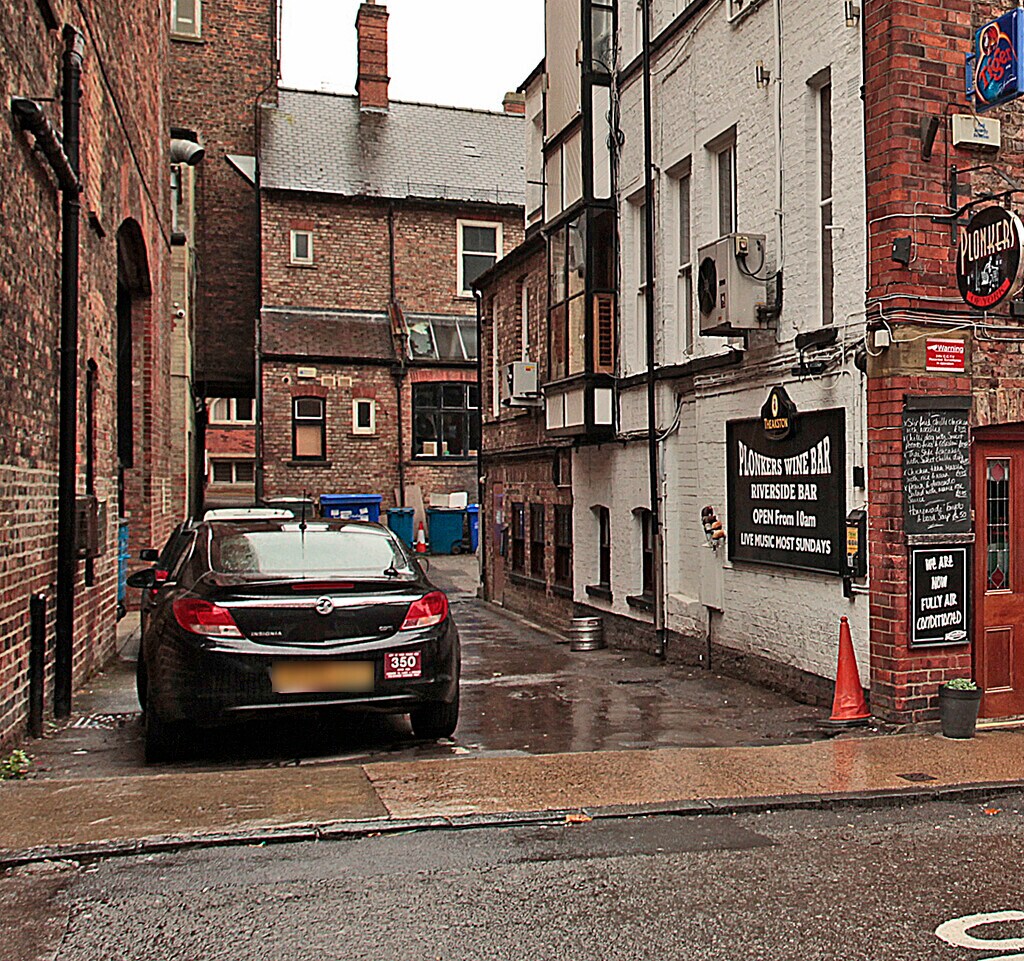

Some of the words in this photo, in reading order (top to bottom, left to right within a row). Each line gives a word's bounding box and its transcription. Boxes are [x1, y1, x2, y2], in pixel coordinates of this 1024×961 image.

[979, 47, 1012, 89] Tiger
[961, 217, 1014, 275] PLONKERS
[938, 345, 963, 353] Warning
[764, 418, 788, 430] THEAKSTON
[738, 440, 782, 476] PLONKERS
[784, 451, 809, 475] WINE
[810, 436, 831, 474] BAR
[751, 484, 796, 499] RIVERSIDE
[798, 484, 817, 500] BAR
[753, 508, 773, 525] OPEN
[775, 510, 794, 526] From
[796, 510, 816, 527] 10am
[740, 533, 754, 546] LIVE
[755, 534, 775, 548] MUSIC
[776, 536, 794, 550] MOST
[796, 537, 831, 554] SUNDAYS
[931, 576, 948, 590] NOW
[921, 595, 943, 611] FULLY
[944, 593, 957, 607] AIR
[391, 656, 416, 668] 350
